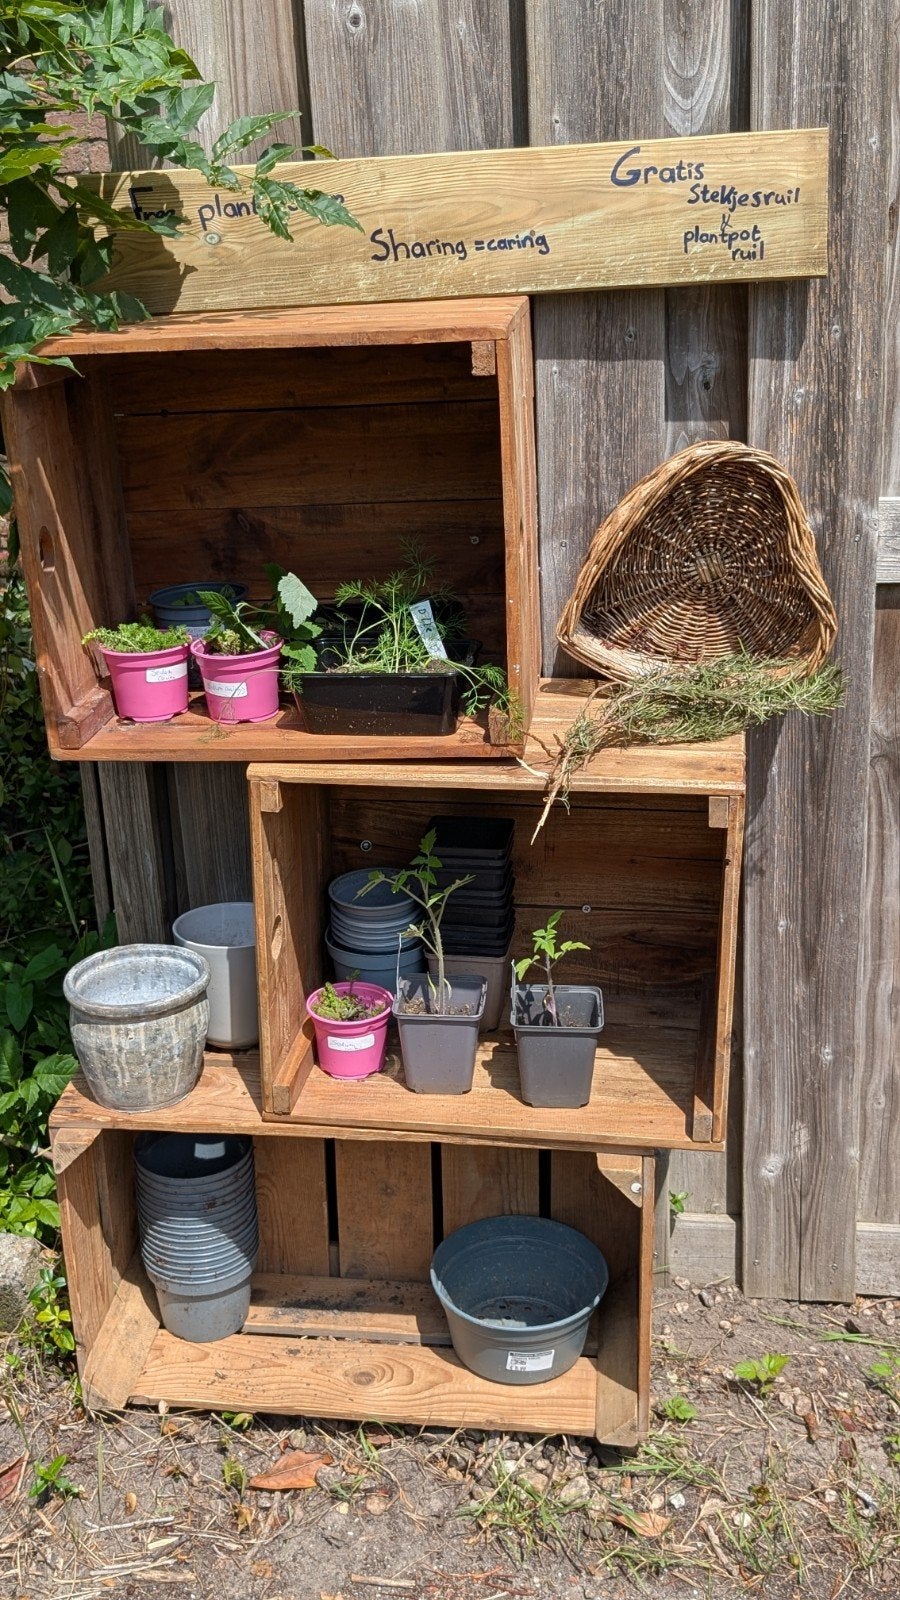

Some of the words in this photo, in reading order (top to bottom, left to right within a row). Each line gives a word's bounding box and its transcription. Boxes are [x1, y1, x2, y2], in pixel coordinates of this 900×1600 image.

[610, 146, 704, 187] Gratis
[687, 183, 800, 212] Stekjesruil
[370, 228, 468, 261] Sharing
[683, 224, 761, 253] plantpot
[731, 240, 765, 261] ruil
